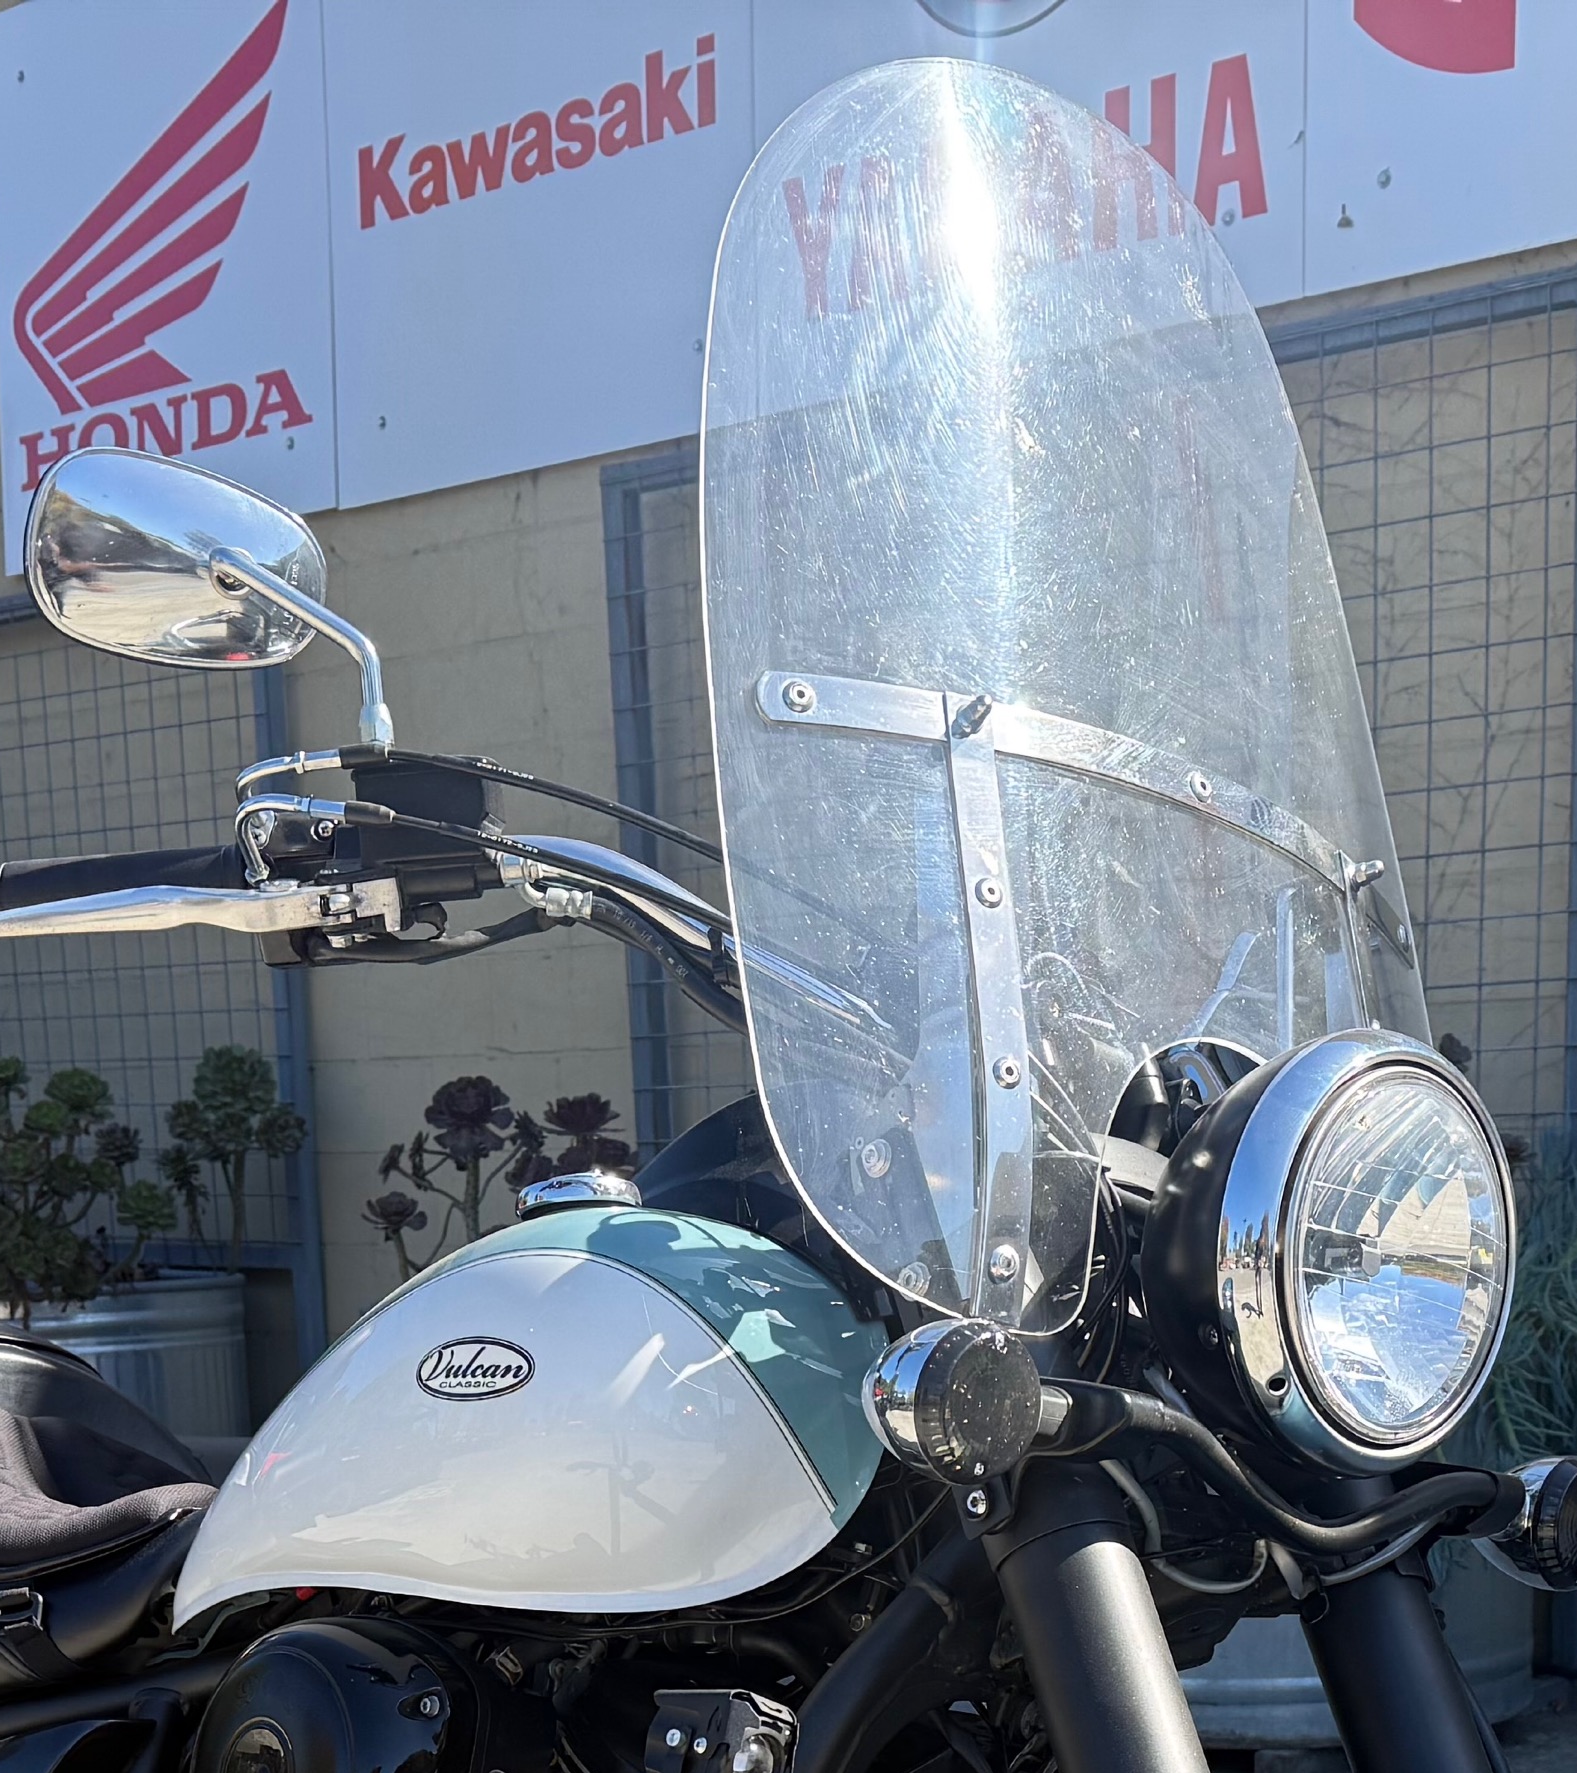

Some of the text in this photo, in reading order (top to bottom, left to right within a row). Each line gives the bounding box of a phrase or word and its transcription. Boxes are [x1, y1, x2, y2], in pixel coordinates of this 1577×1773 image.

[358, 33, 717, 230] Kawasaki
[782, 53, 1269, 318] YAAHA
[424, 1346, 526, 1382] Vulcan
[439, 1380, 497, 1389] CLASSIC
